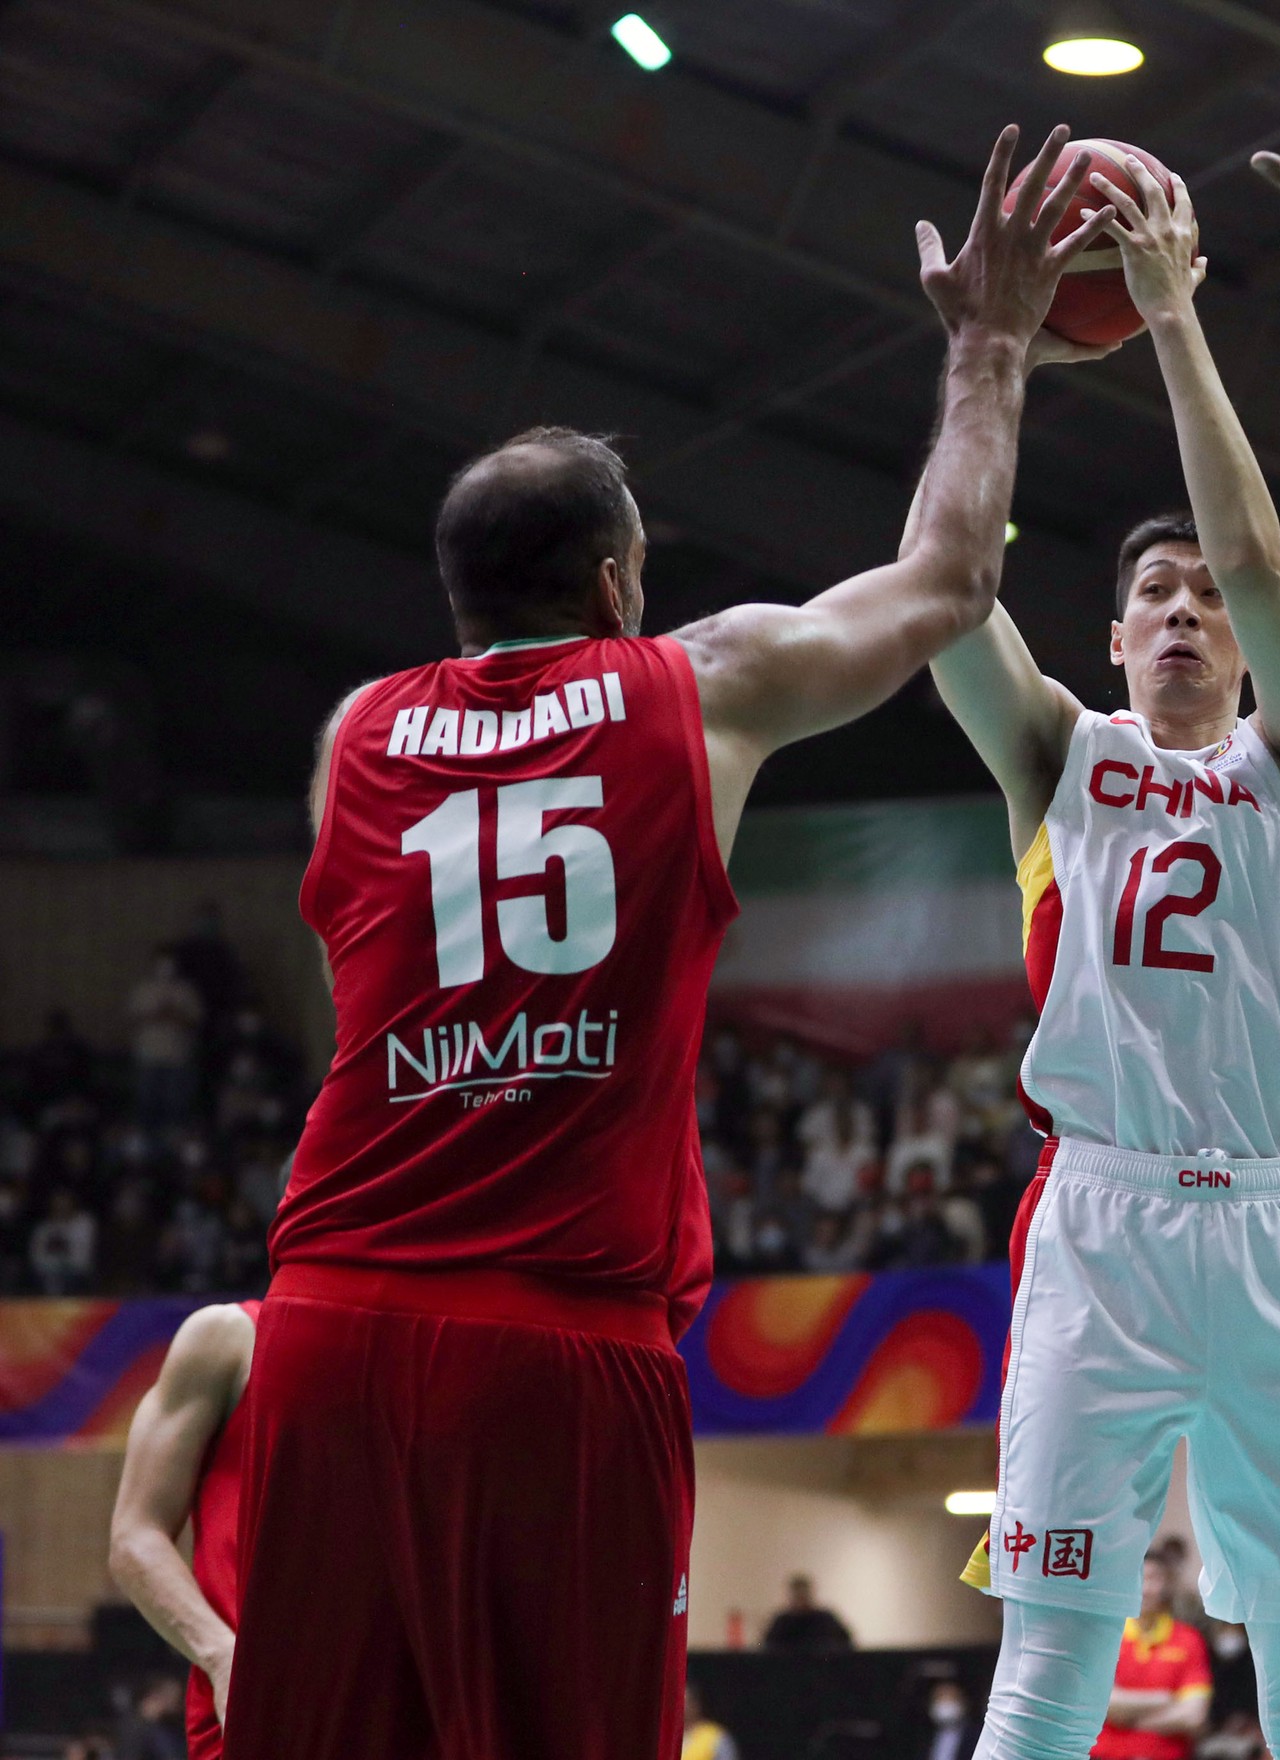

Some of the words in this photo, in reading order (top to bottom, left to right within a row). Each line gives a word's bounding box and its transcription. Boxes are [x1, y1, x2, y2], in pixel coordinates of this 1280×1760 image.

[386, 672, 627, 757] HADDADI
[1089, 759, 1262, 818] CHINA
[401, 775, 617, 989] 15
[1112, 841, 1223, 974] 12
[387, 1009, 618, 1090] NilMoti
[459, 1088, 532, 1109] Tehran
[1178, 1169, 1232, 1189] CHN
[1004, 1520, 1094, 1580] 中国
